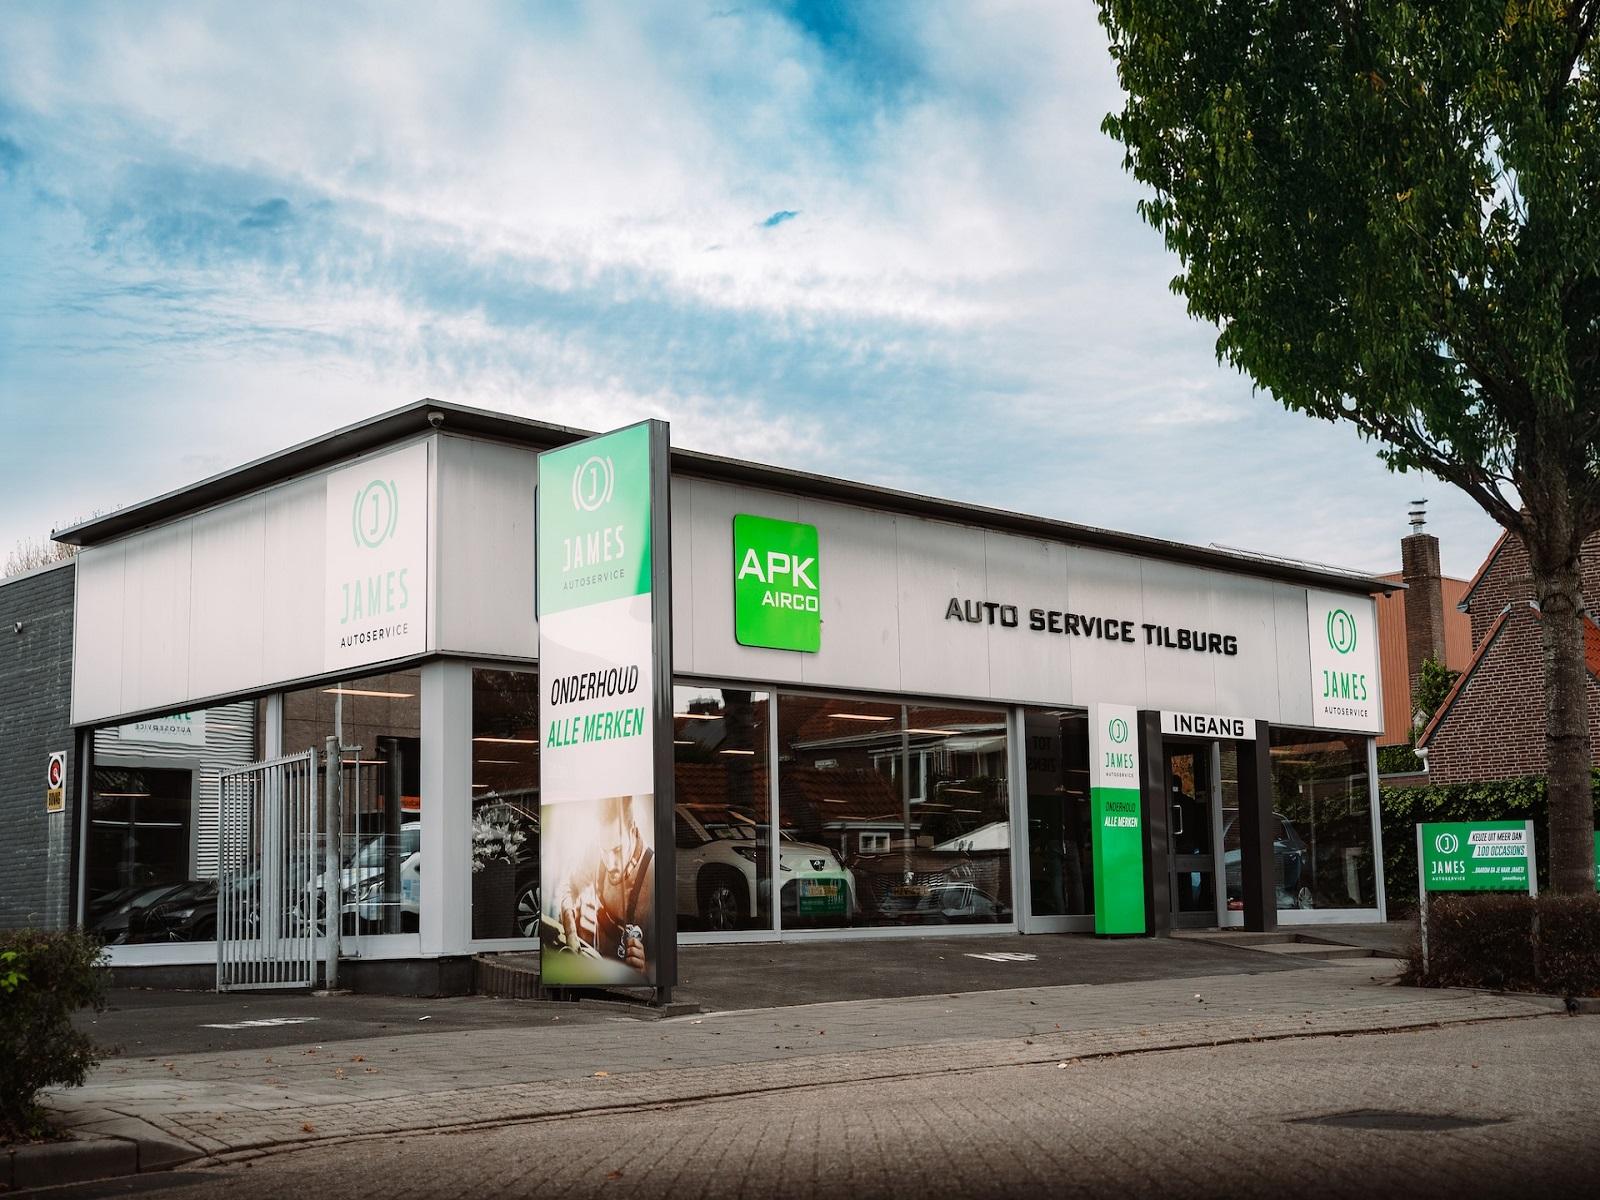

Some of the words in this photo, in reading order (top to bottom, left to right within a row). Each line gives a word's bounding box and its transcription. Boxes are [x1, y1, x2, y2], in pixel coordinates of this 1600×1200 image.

[562, 525, 625, 572] JAMES
[563, 569, 625, 591] AUTOSERVICE
[738, 548, 817, 590] APK
[340, 568, 408, 625] JAMES
[762, 590, 819, 613] AIRCO
[340, 622, 409, 649] AUTOSERVICE
[945, 598, 1019, 628] AUTO
[1029, 608, 1136, 644] SERVICE
[1141, 623, 1238, 656] TILBURG
[550, 664, 640, 706] ONDERHOUD
[1323, 670, 1367, 701] JAMES
[1324, 706, 1369, 718] AUTOSERVICE
[546, 716, 581, 748] ALLE
[582, 706, 645, 743] MERKEN
[1174, 714, 1244, 737] INGANG
[1105, 752, 1134, 769] JAMES
[1105, 801, 1136, 813] ONDERHOUD
[1104, 816, 1118, 827] ALLE
[1118, 817, 1138, 828] MERKEN
[1472, 832, 1488, 842] KEUZE
[1488, 832, 1497, 842] UIT
[1497, 832, 1511, 841] MEER
[1511, 831, 1523, 841] DAN
[1477, 846, 1490, 857] 100
[1490, 845, 1526, 856] OCCASIONS
[1431, 860, 1466, 875] JAMES
